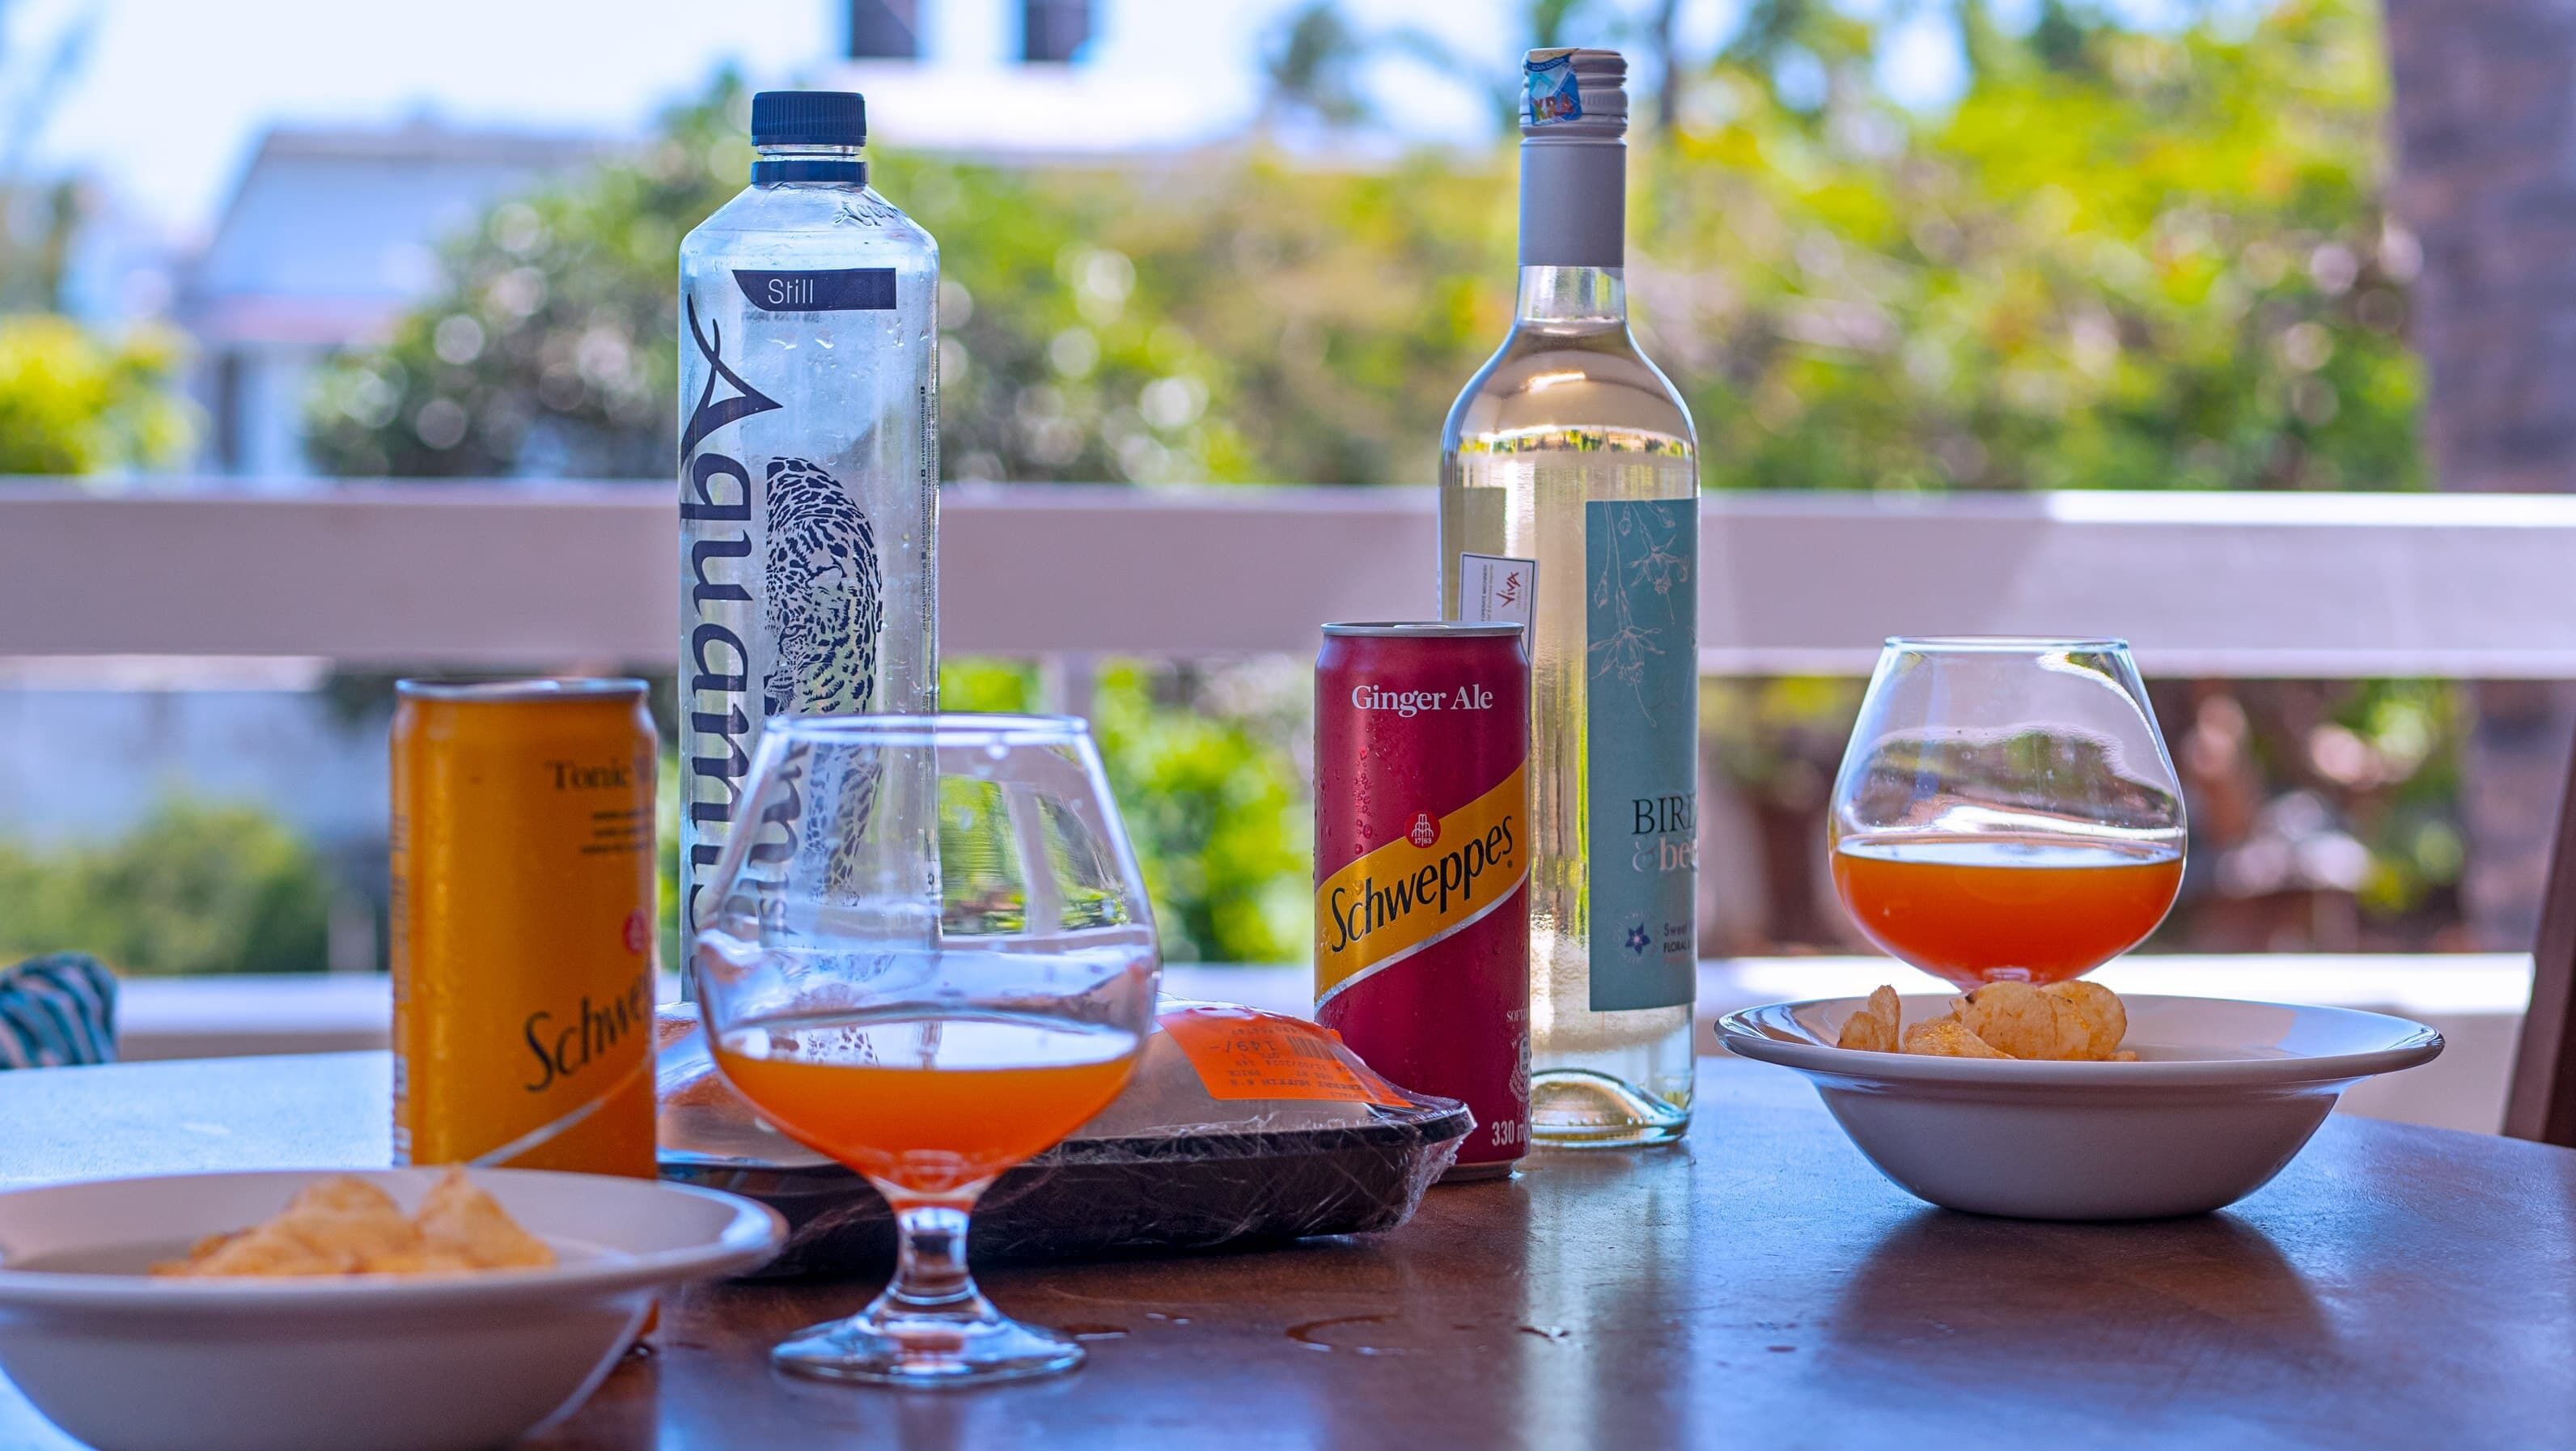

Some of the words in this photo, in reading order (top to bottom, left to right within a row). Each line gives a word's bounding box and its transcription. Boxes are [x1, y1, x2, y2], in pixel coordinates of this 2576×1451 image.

[768, 278, 813, 304] Still
[1352, 685, 1447, 718] Ginger
[1450, 684, 1493, 710] Ale
[1331, 815, 1514, 953] Schweppes
[1491, 1119, 1515, 1147] 330
